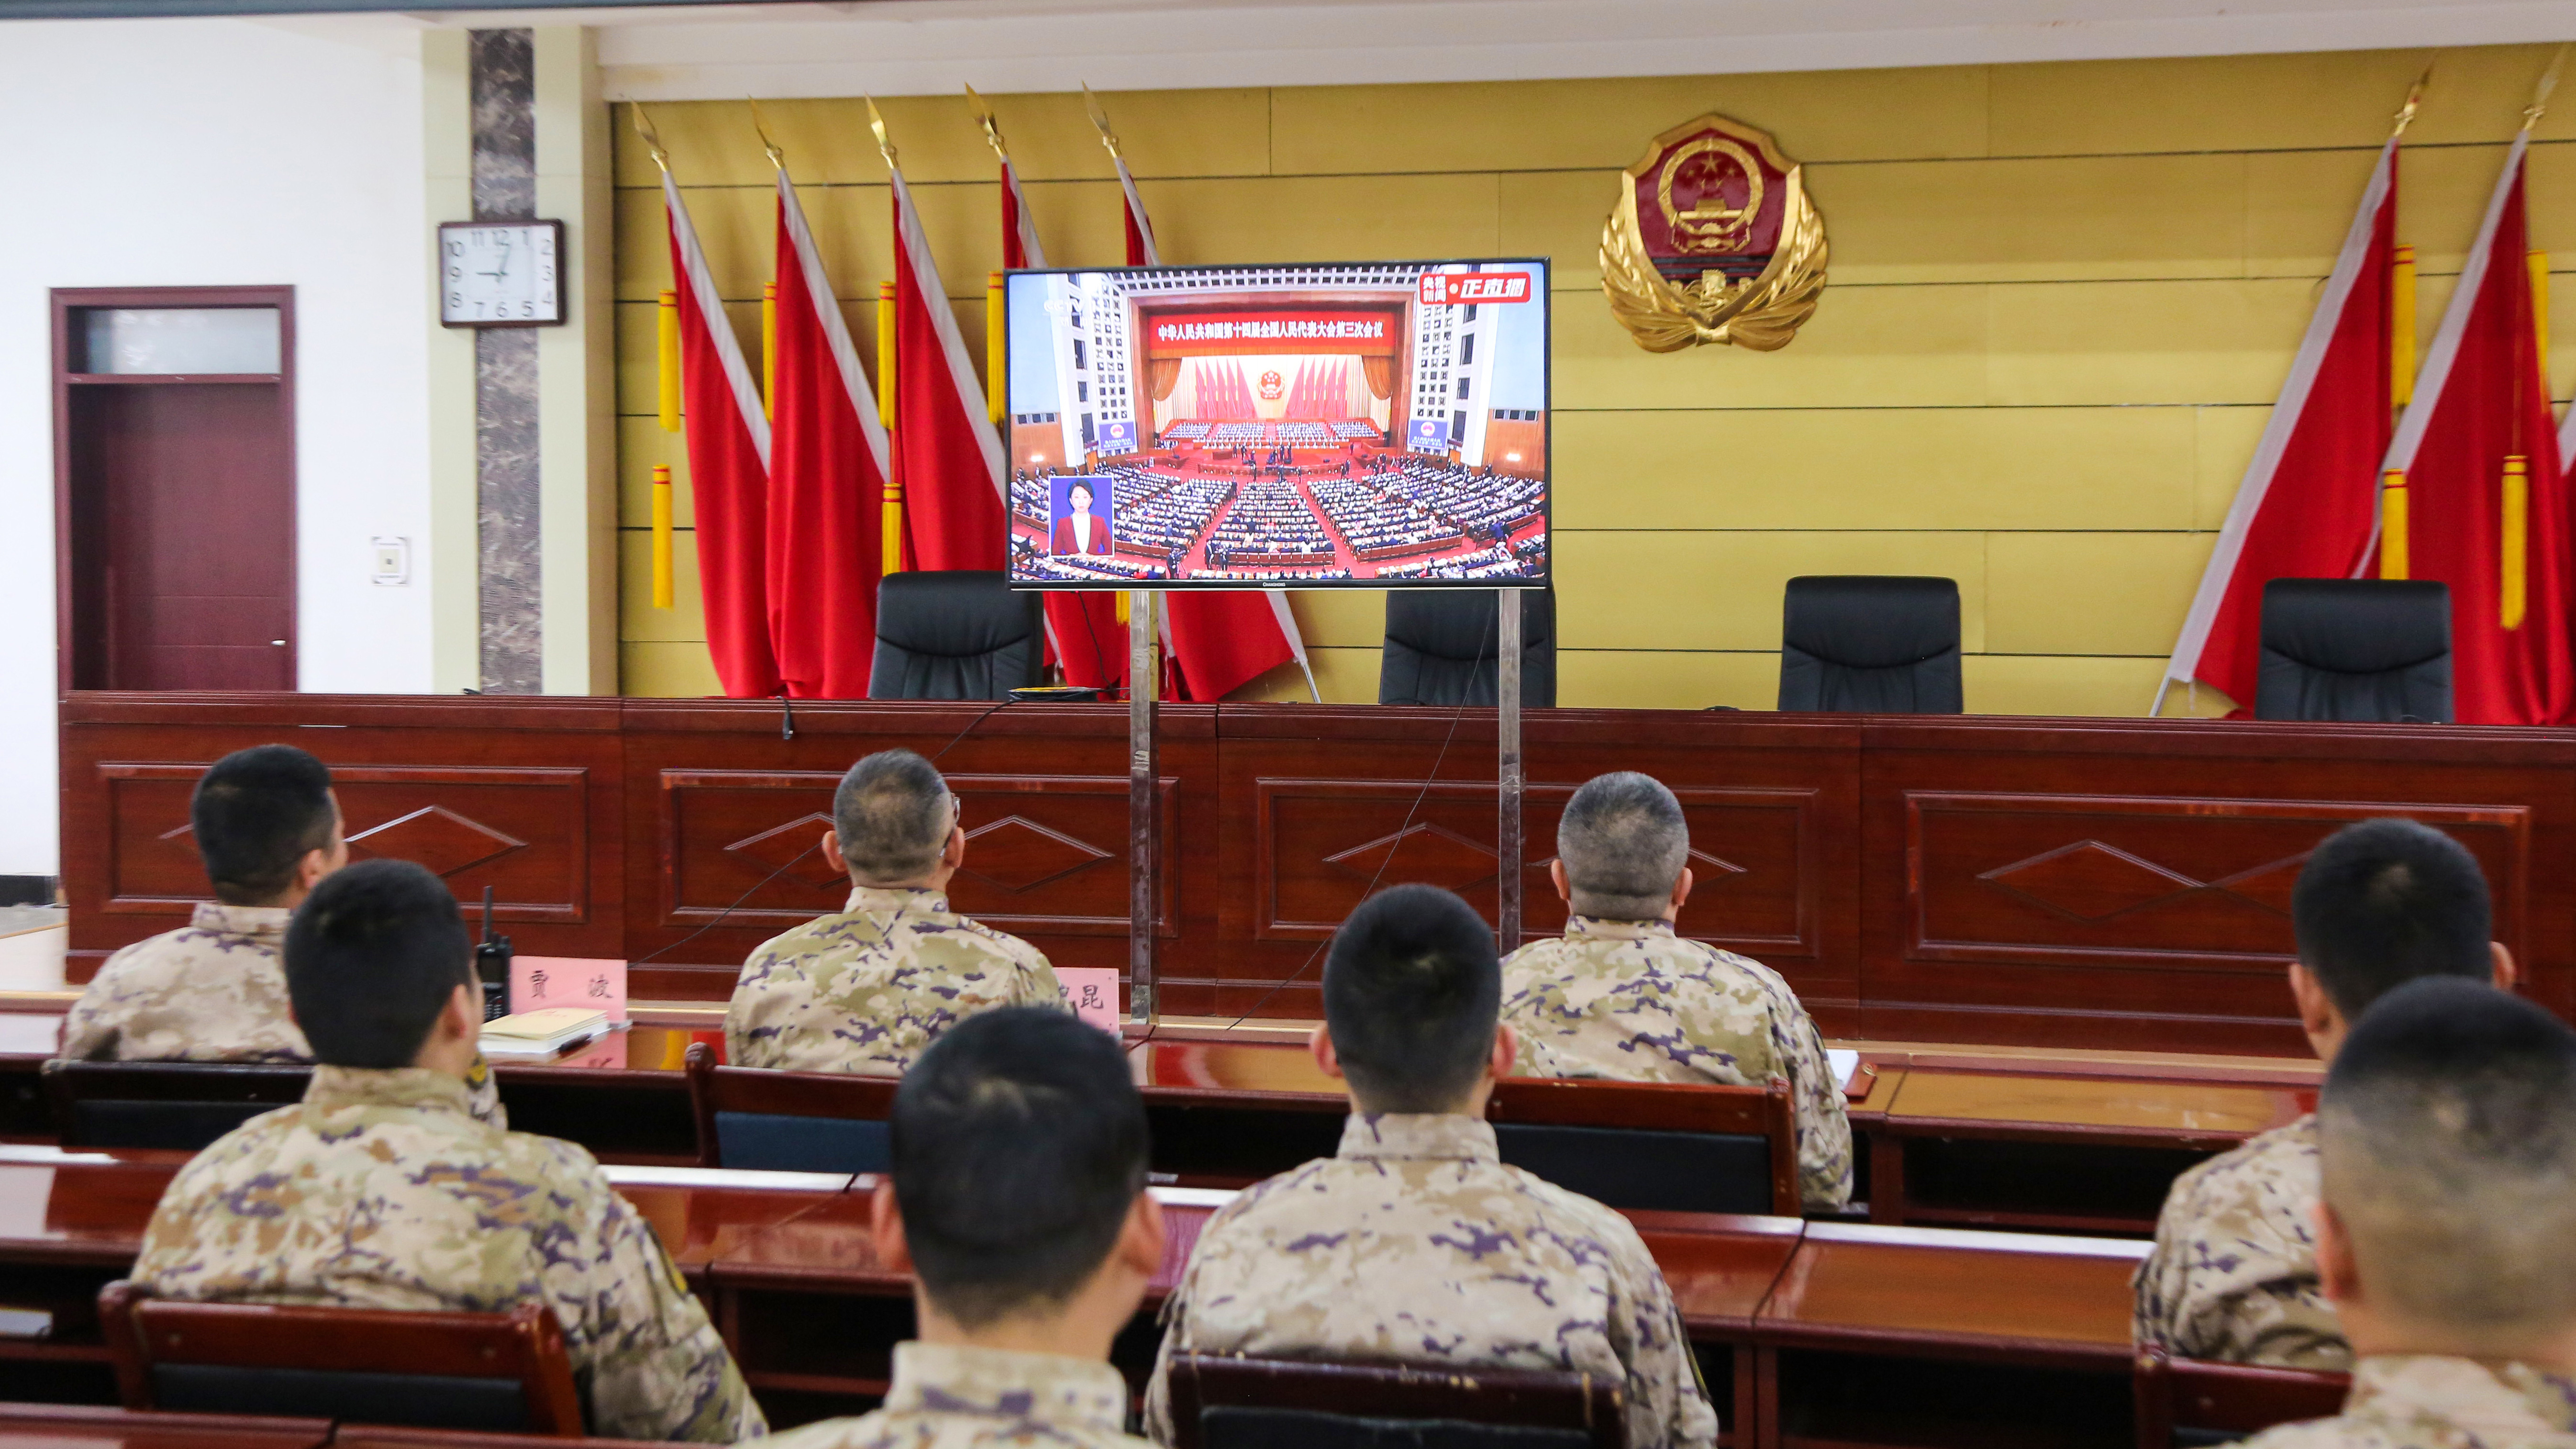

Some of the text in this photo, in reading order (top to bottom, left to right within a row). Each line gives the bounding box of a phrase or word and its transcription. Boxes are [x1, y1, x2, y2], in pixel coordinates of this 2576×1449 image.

[450, 266, 462, 282] 9
[450, 291, 463, 308] 8
[474, 301, 486, 318] 7
[495, 301, 509, 318] 6
[522, 301, 535, 317] 5
[1158, 320, 1383, 342] 中华人民共和国第十四届全国人民代表大会第三次会议
